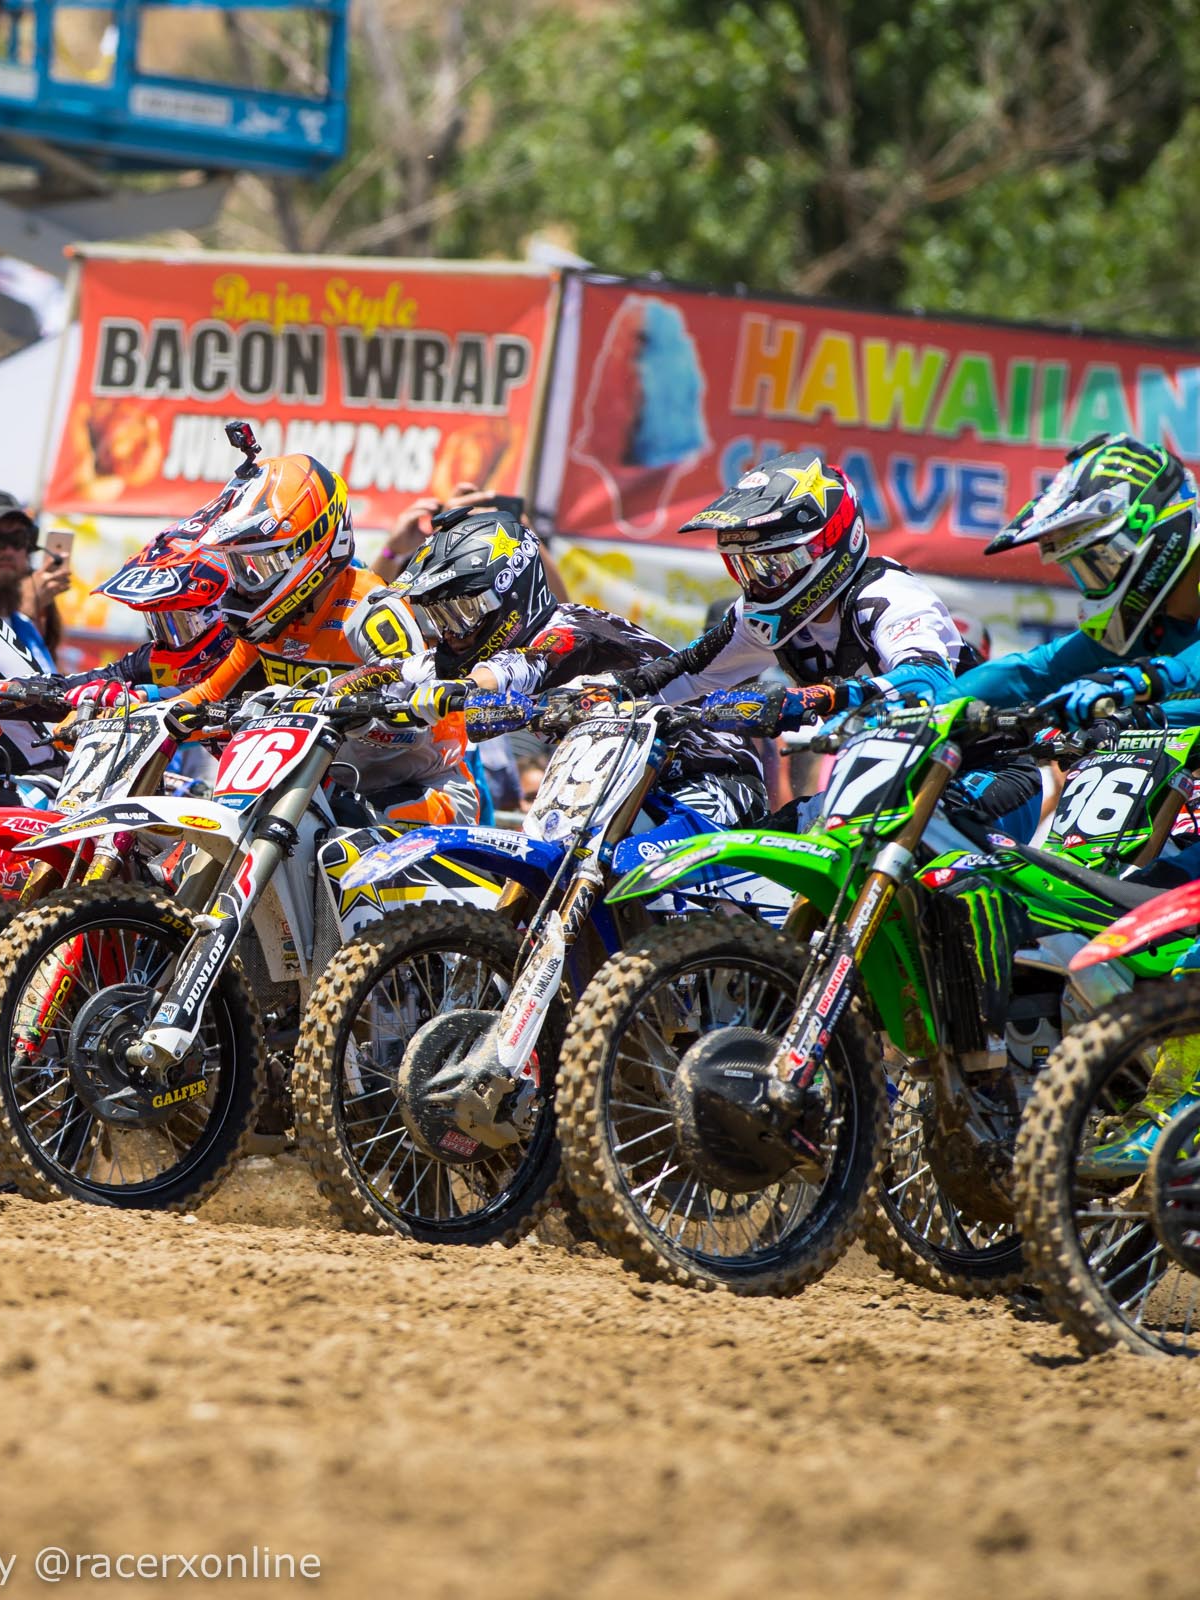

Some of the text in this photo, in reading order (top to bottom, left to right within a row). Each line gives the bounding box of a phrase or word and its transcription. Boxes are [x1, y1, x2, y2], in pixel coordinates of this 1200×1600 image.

[212, 274, 417, 339] Baja Style
[93, 317, 533, 415] BACON WRAP
[730, 312, 1200, 461] HAWAIIAN
[162, 414, 283, 482] JUMO
[349, 423, 441, 492] DOGS
[718, 439, 1007, 540] AVE
[286, 494, 344, 561] 100%
[852, 524, 862, 547] BELL
[266, 570, 326, 624] GEICO
[425, 570, 457, 587] Airoh
[215, 731, 297, 791] 16
[877, 727, 897, 739] OIL
[1088, 753, 1136, 767] LUCAS OIL
[823, 739, 925, 817] 17
[1052, 767, 1154, 836] 36
[758, 836, 839, 861] CIRCUIT
[43, 976, 72, 1033] GEICO
[183, 934, 228, 1017] DUNLOP
[509, 957, 562, 1048] BRAKING YAMALUBE
[817, 956, 852, 1015] BRAKING
[152, 1080, 208, 1109] GALFER
